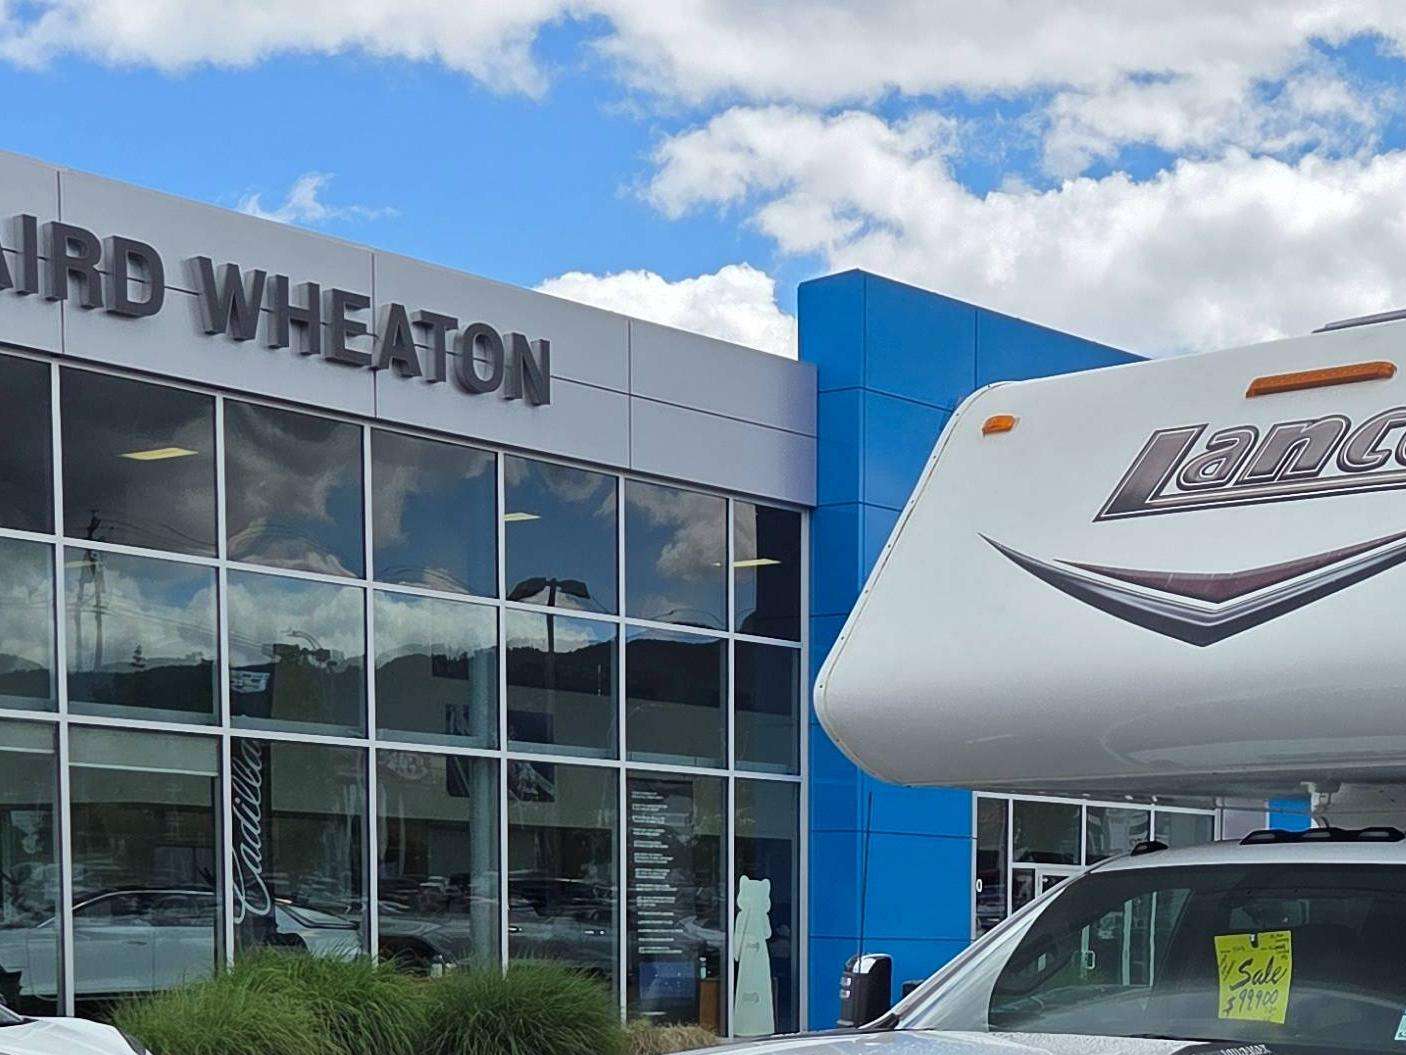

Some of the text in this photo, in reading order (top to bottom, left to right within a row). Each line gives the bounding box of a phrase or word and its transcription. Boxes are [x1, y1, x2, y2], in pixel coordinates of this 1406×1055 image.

[0, 213, 551, 405] IRD WHEATON
[233, 738, 271, 924] Cadilla
[1229, 956, 1287, 991] Sale
